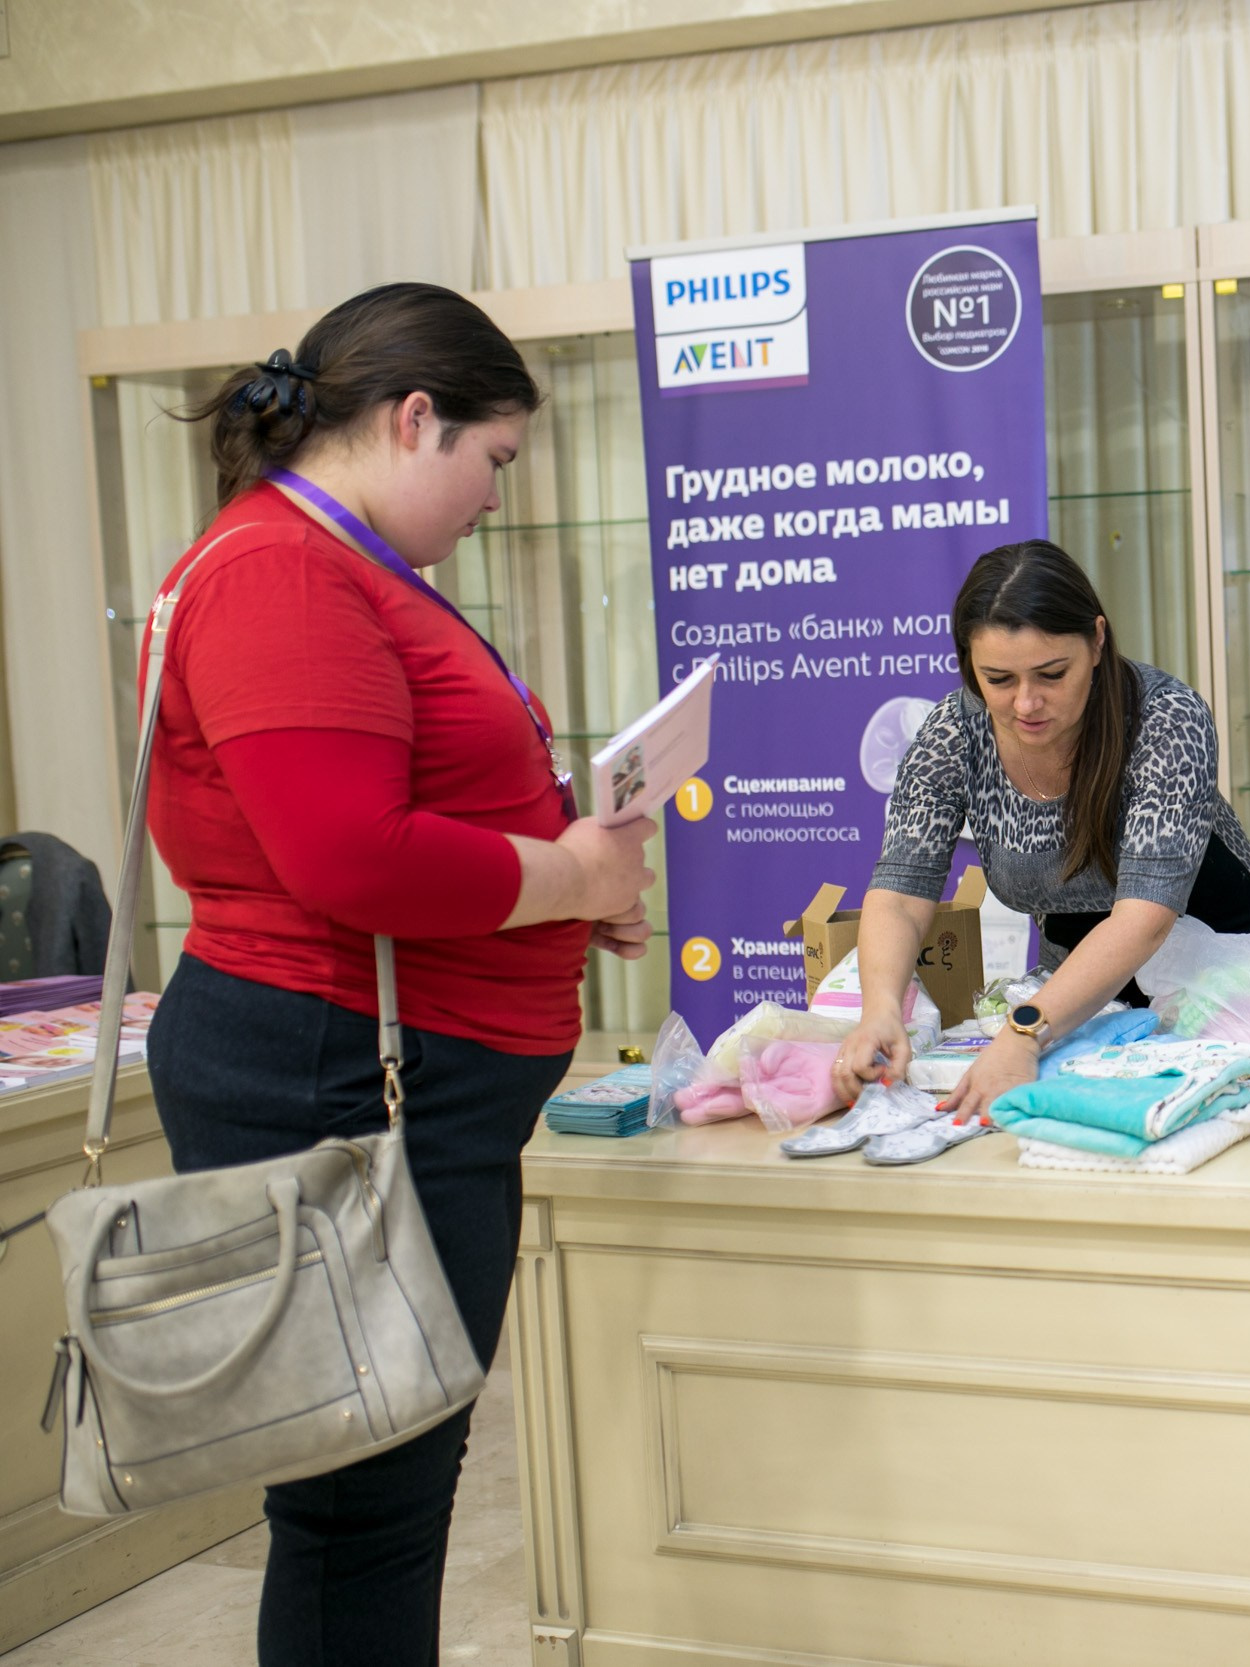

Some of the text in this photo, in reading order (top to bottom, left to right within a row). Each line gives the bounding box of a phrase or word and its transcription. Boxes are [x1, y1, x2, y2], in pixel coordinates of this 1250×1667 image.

[665, 269, 791, 307] PHILIPS
[672, 336, 774, 375] AVENT
[666, 451, 984, 503] Грудное молоко,
[667, 499, 1009, 550] даже когда мамы
[670, 557, 837, 592] нет дома
[672, 621, 781, 647] Создать
[789, 614, 883, 640] «банк»
[790, 652, 872, 679] Avent
[686, 783, 699, 812] 1
[723, 775, 846, 795] Сцеживание
[725, 802, 834, 819] с помощью
[727, 826, 860, 842] молокоотсоса
[692, 944, 712, 972] 2
[733, 965, 743, 980] в
[748, 965, 807, 982] специ
